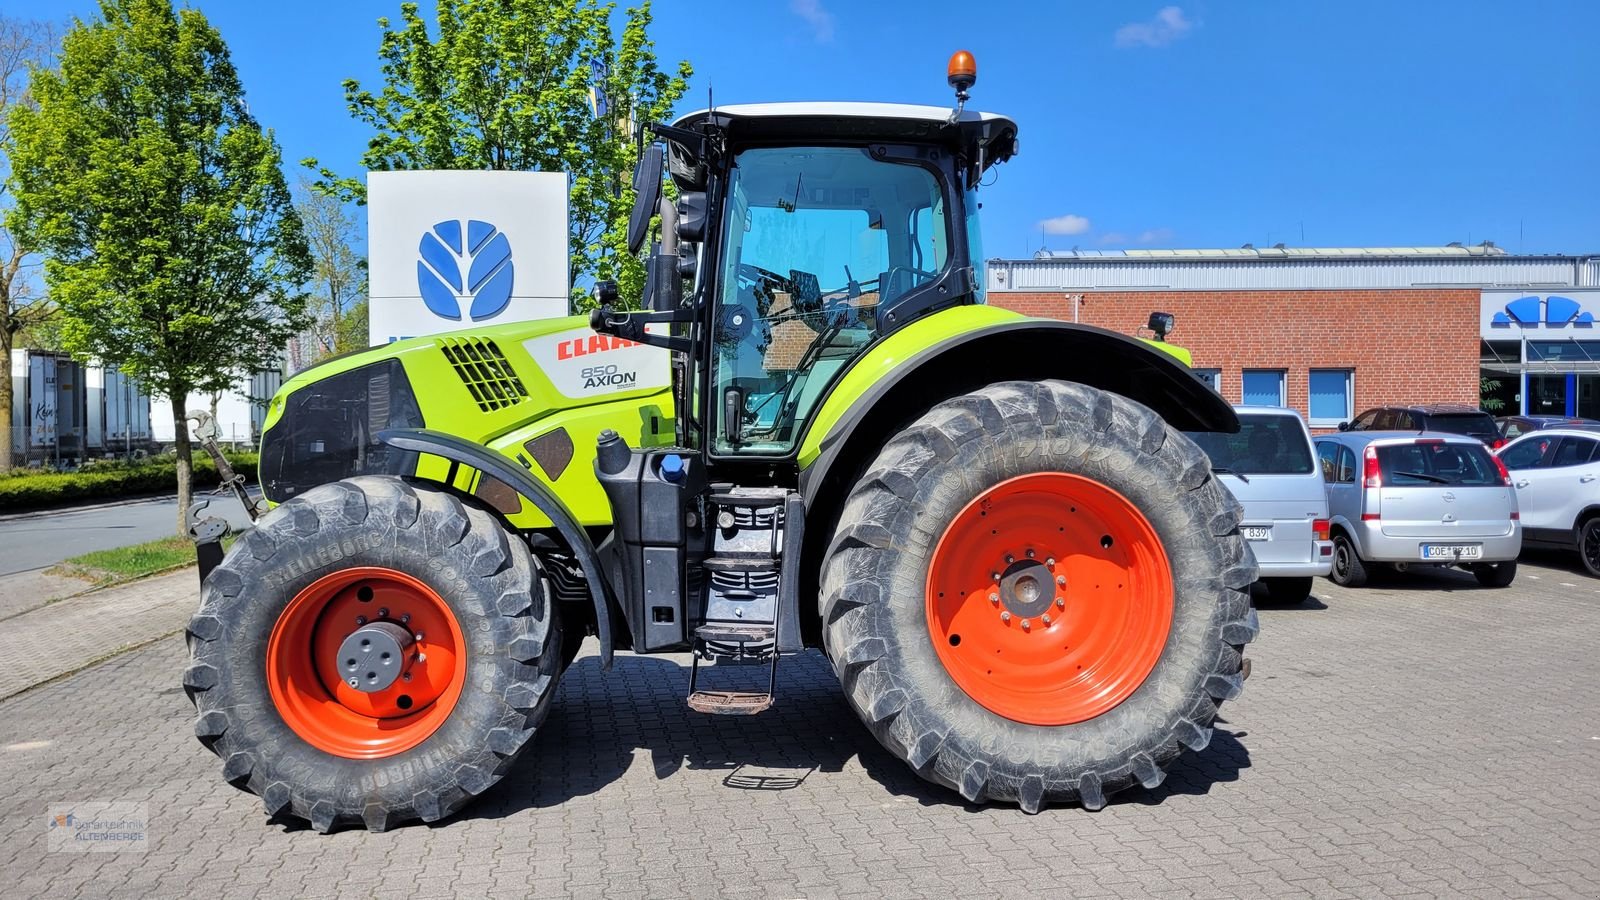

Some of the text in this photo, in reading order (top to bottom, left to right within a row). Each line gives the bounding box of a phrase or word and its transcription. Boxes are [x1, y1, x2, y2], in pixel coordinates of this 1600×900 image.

[558, 328, 650, 360] CLAA
[581, 364, 618, 379] 850
[584, 372, 636, 389] AXION
[1249, 528, 1267, 538] 839
[1429, 546, 1447, 556] COE
[1466, 546, 1477, 556] 10
